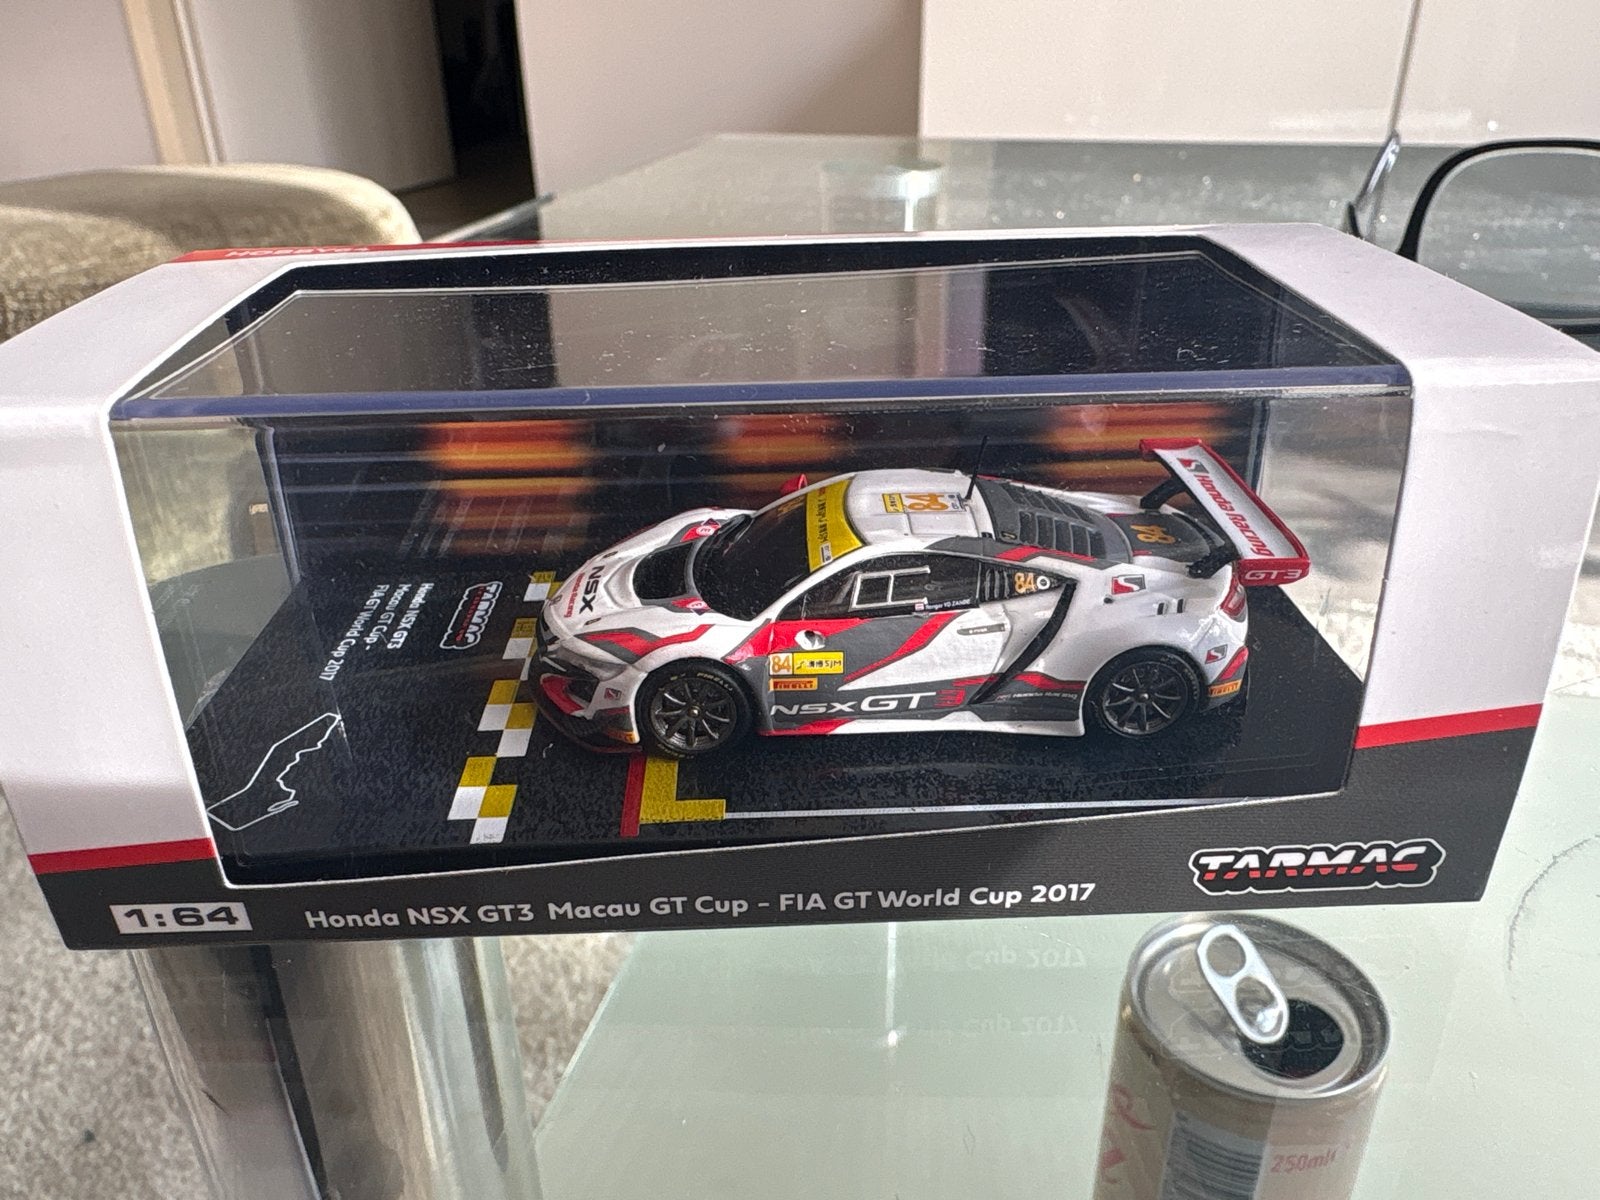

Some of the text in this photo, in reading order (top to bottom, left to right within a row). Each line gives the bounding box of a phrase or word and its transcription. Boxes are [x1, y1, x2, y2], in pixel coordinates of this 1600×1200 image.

[1193, 473, 1276, 558] Honda Racing
[1014, 572, 1037, 594] 84
[1244, 568, 1303, 581] GT3
[385, 583, 412, 611] Macau
[579, 565, 606, 615] NSX
[377, 612, 395, 625] GT
[387, 582, 435, 649] Honda NSX GT3
[319, 584, 390, 681] FIA GT World Cup 2017
[363, 625, 388, 644] Cup
[771, 655, 791, 673] 84
[771, 702, 854, 716] NSX
[1198, 844, 1428, 881] TARMAC
[122, 904, 239, 929] 1:64
[304, 908, 400, 929] Honda
[407, 905, 472, 926] NSX
[477, 903, 535, 923] GT3
[548, 900, 642, 920] Macau
[649, 896, 688, 915] GT
[695, 895, 749, 918] Cup
[779, 893, 827, 912] FIA
[833, 890, 873, 909] GT
[877, 887, 961, 908] World
[969, 886, 1022, 909] Cup
[1031, 883, 1096, 904] 2017
